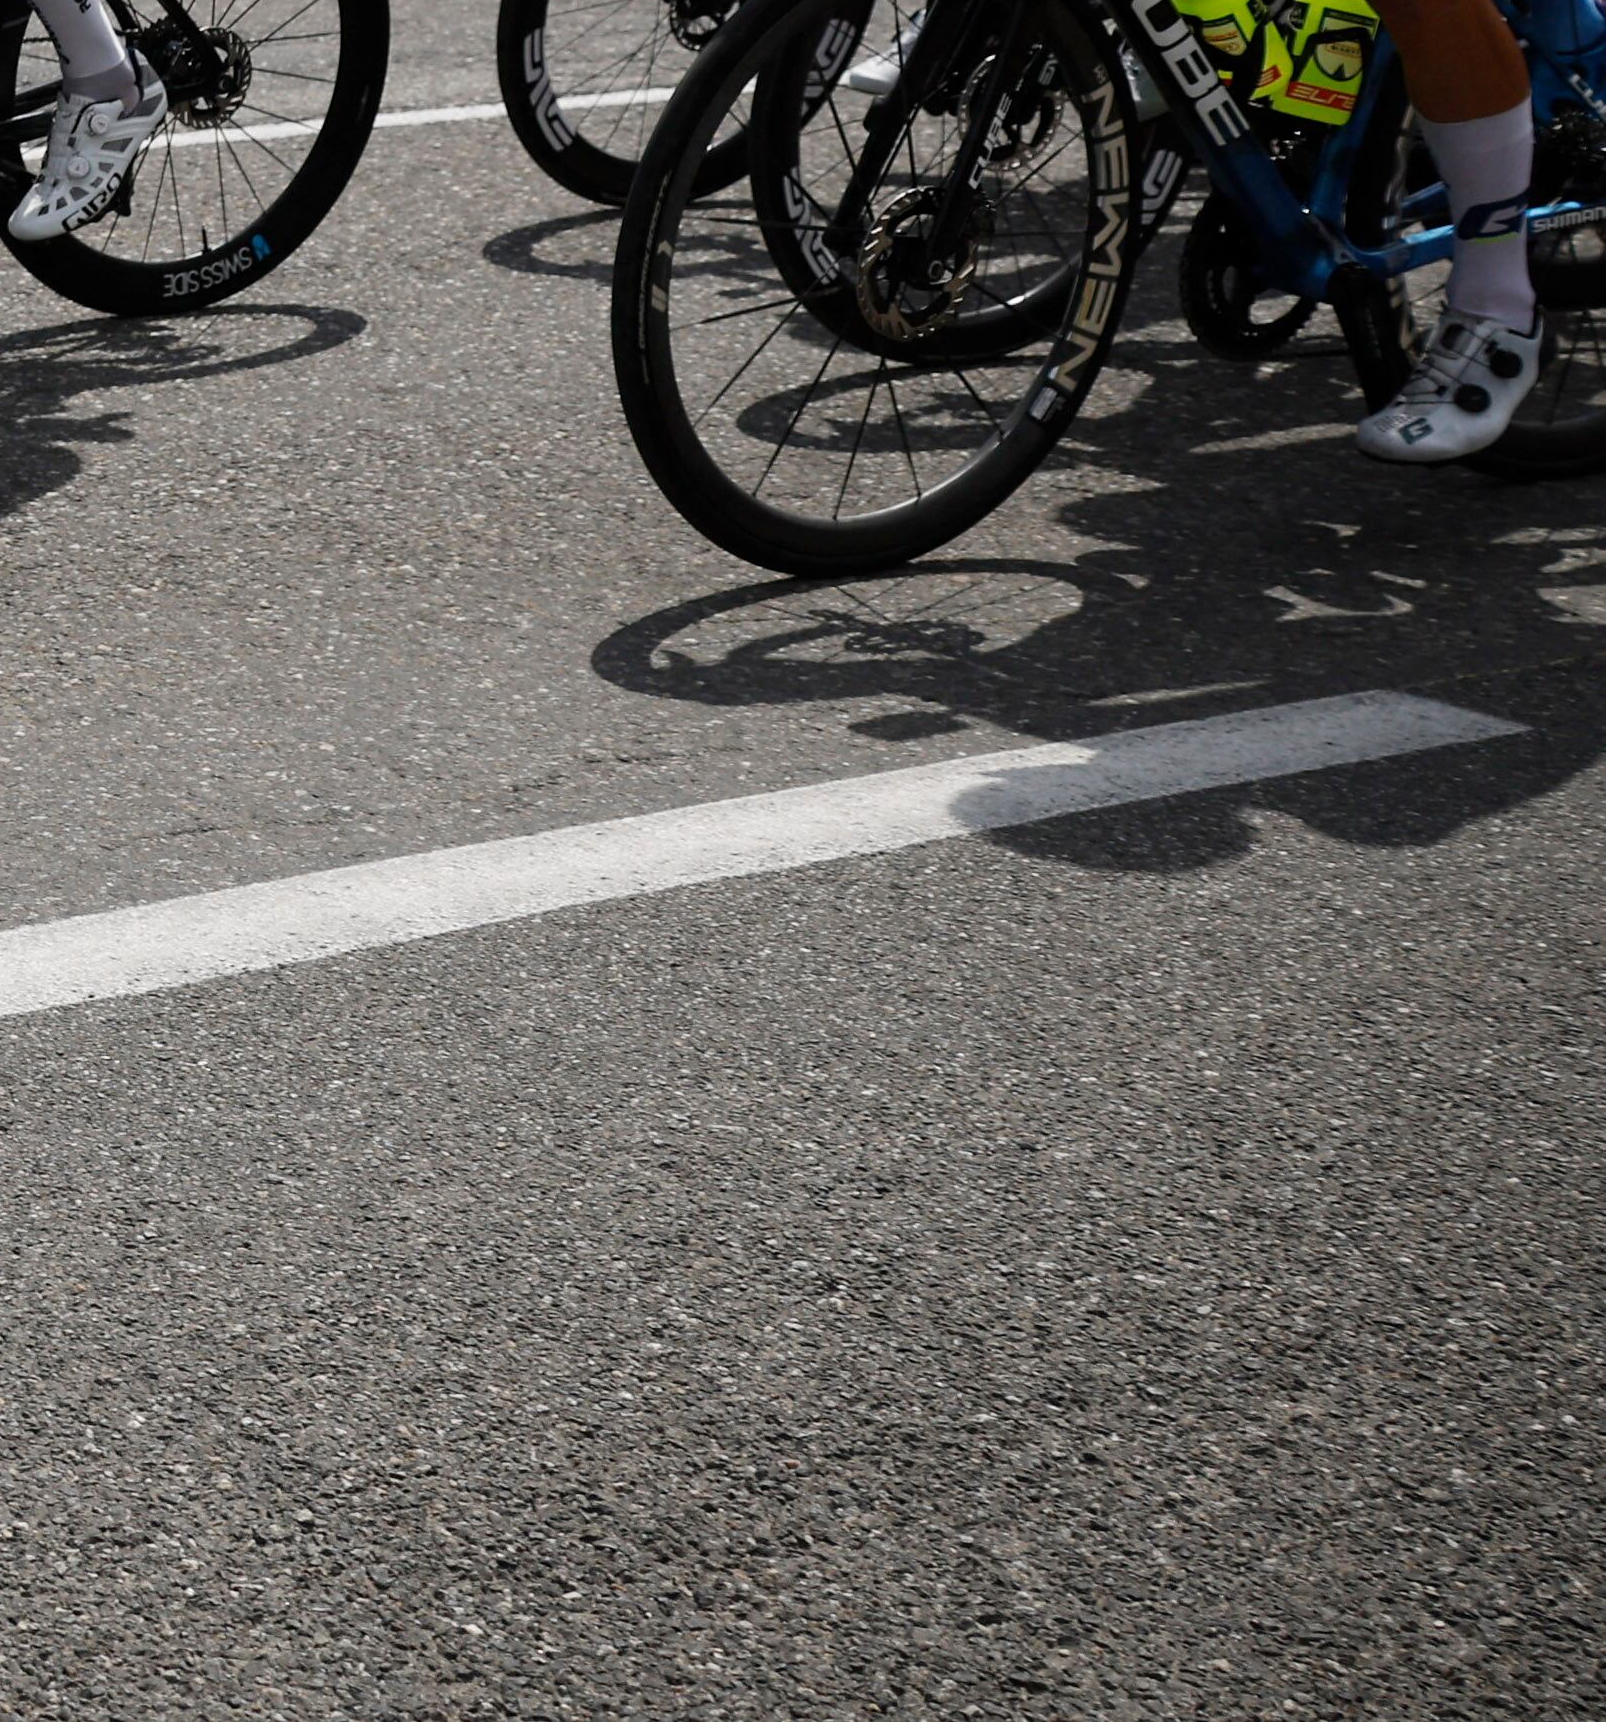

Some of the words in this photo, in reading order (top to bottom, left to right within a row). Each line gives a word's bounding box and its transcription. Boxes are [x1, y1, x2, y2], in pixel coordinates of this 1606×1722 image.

[61, 172, 122, 232] GIRO
[162, 274, 202, 298] SIDE
[200, 246, 254, 291] SWISS
